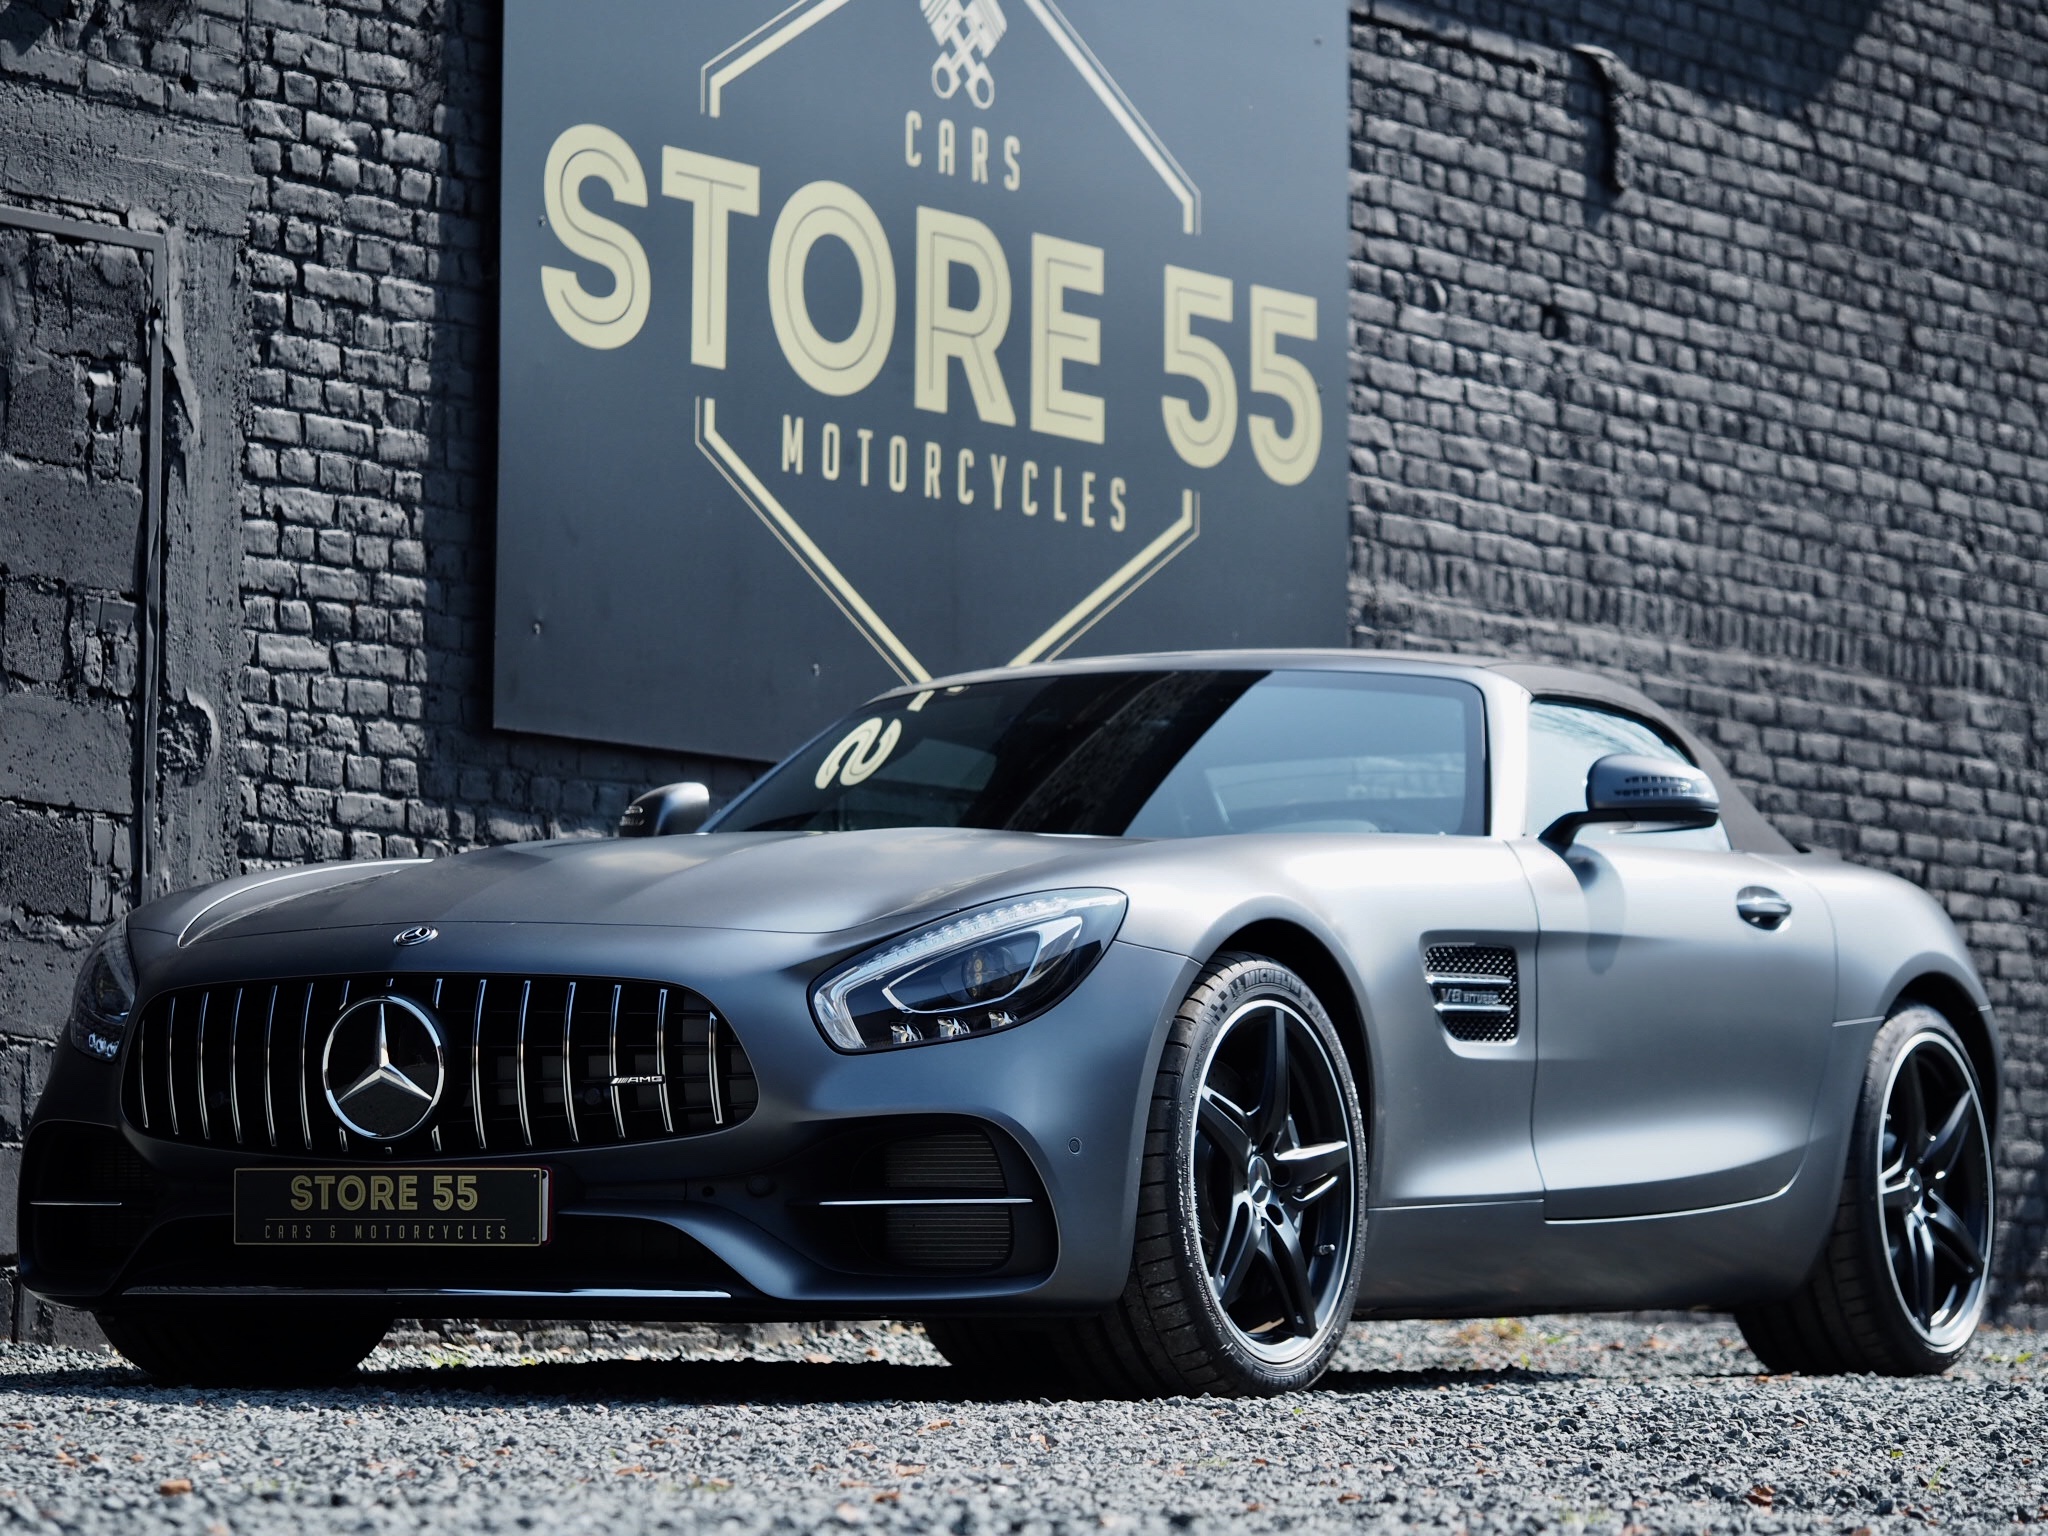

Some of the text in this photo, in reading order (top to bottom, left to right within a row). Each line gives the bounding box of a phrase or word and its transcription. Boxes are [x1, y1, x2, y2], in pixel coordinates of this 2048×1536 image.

[905, 110, 1021, 191] CARS
[541, 123, 1323, 487] STORE 55
[782, 414, 1126, 533] MOTORCYCLES
[1244, 968, 1301, 997] MICHELIN
[626, 1075, 663, 1084] AMG
[290, 1174, 478, 1211] STORE 55
[264, 1224, 507, 1240] CARS & MOTORCYCLES
